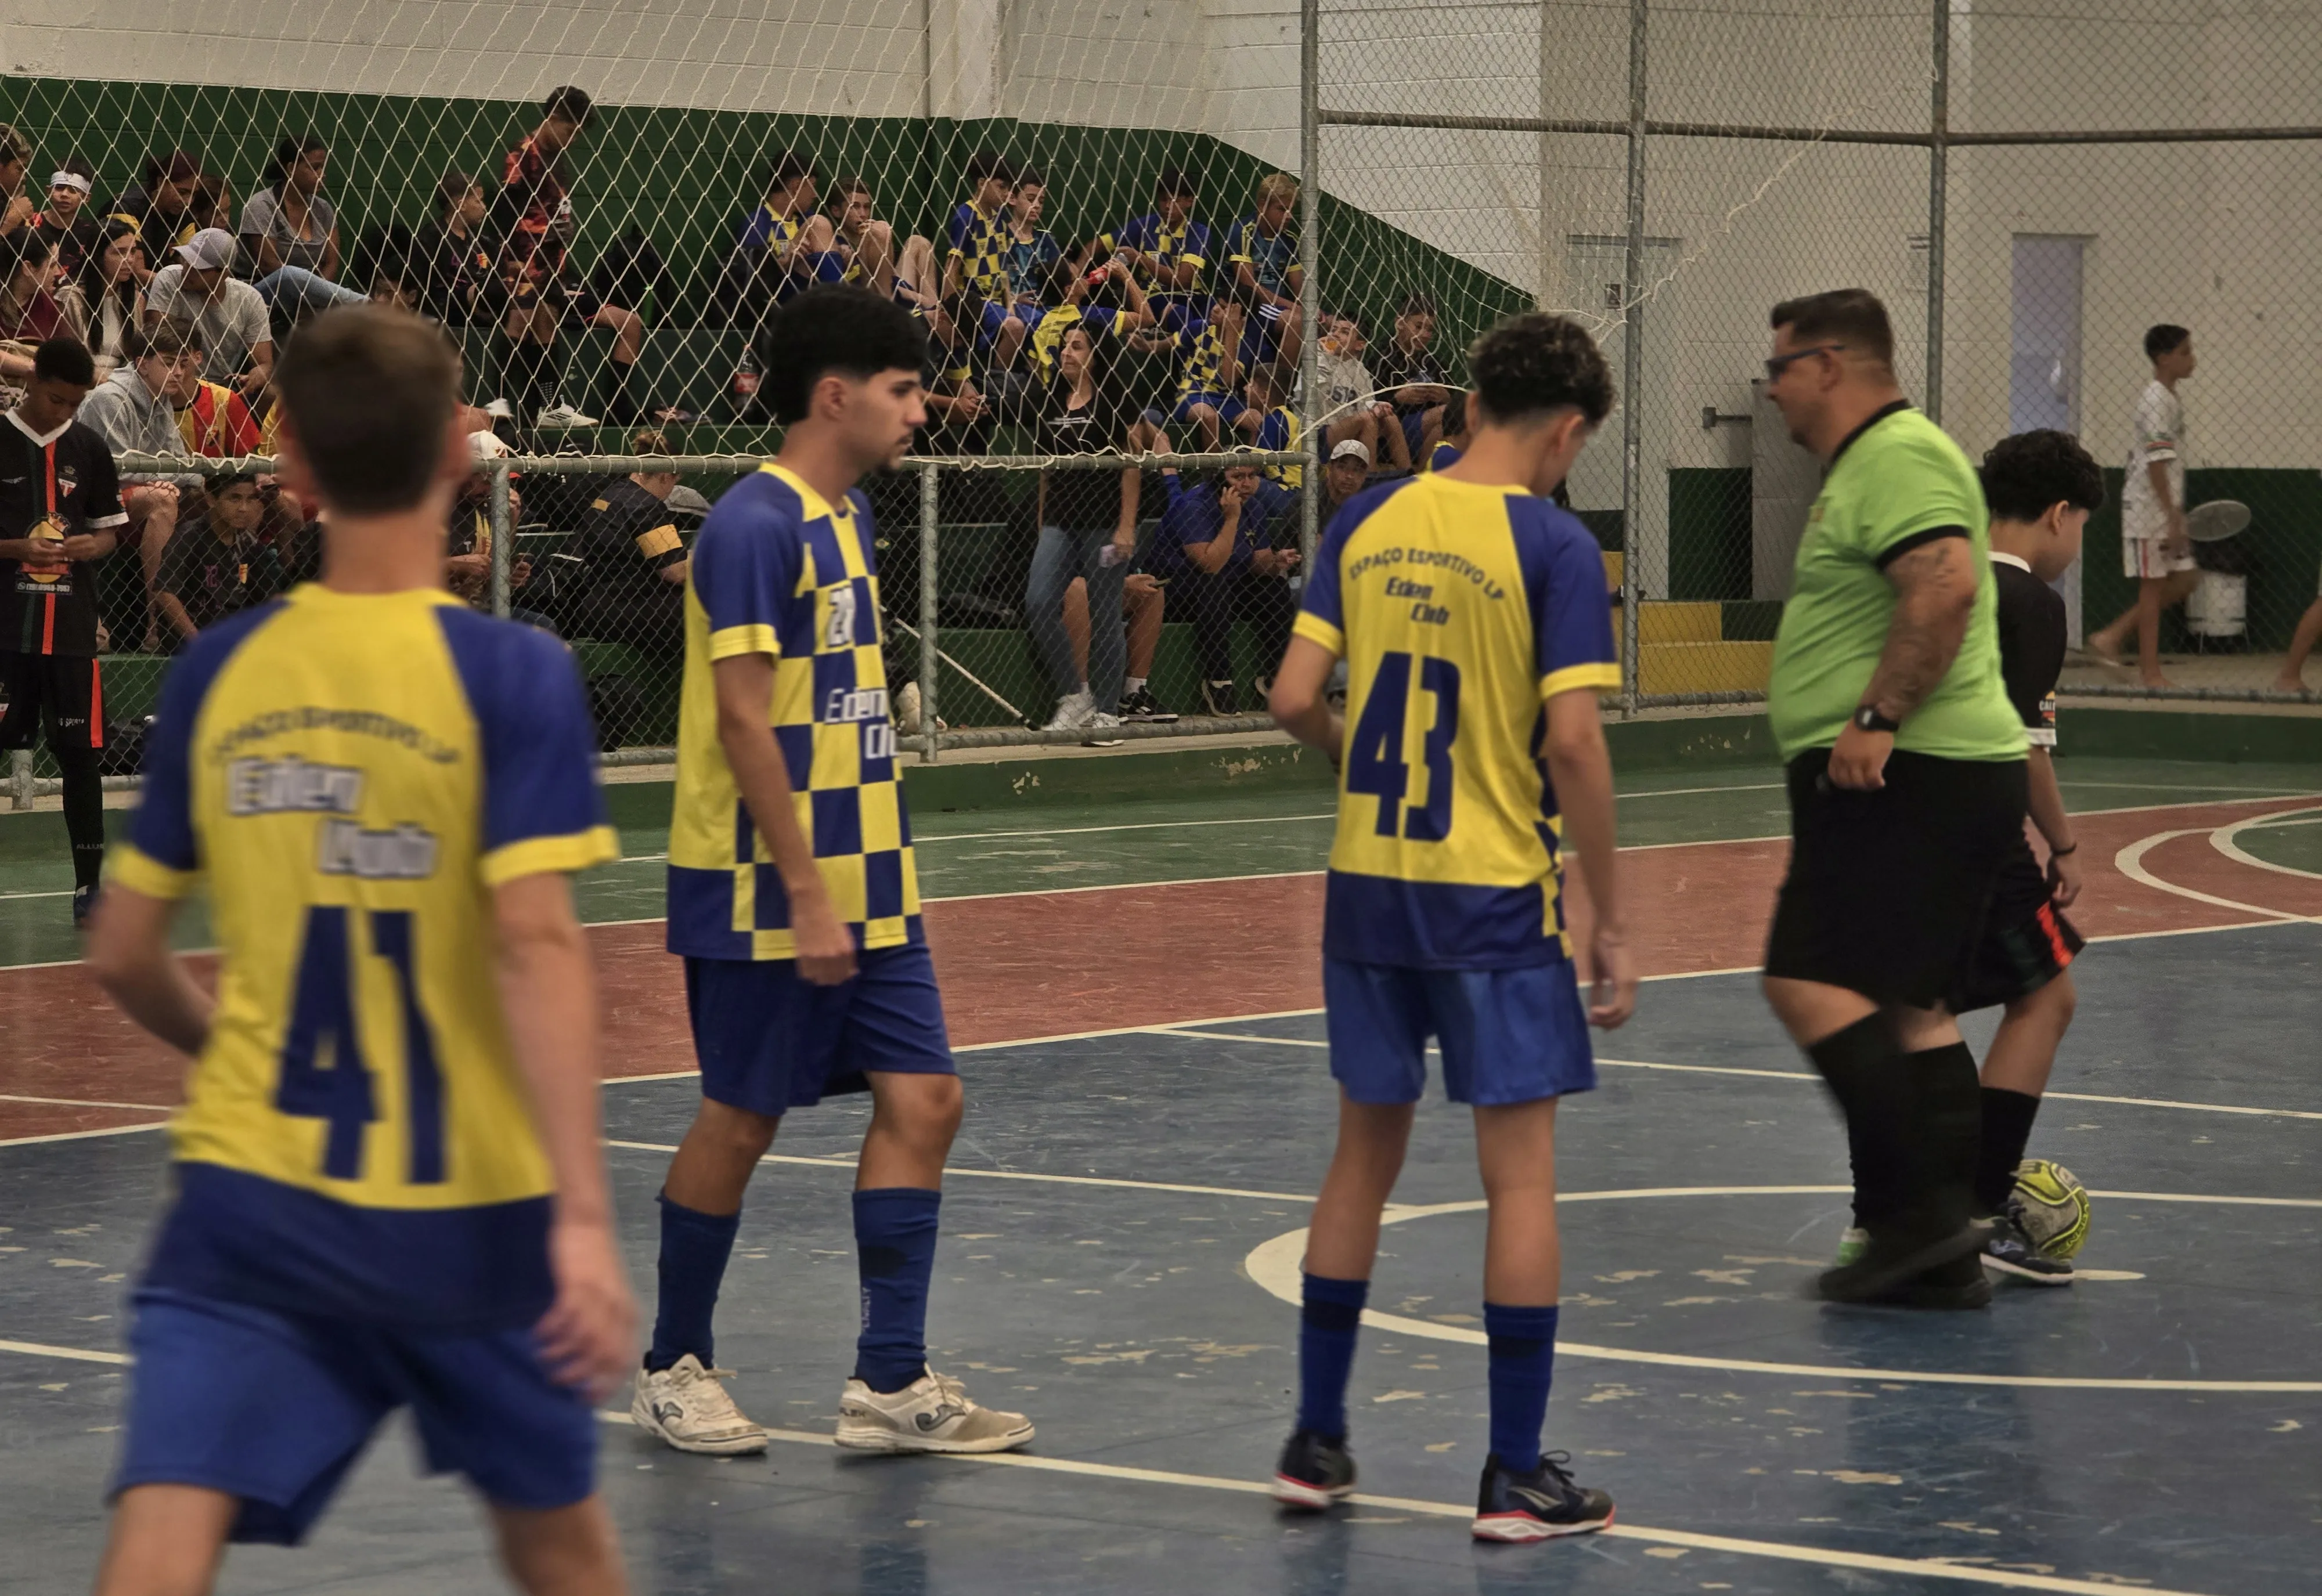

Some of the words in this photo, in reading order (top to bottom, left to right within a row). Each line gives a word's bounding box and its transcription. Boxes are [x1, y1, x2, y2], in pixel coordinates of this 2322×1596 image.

[1349, 547, 1403, 580] ESPAÇO
[1407, 548, 1485, 584] ESPORTIVO
[1385, 576, 1434, 600] Eden
[1410, 602, 1450, 626] Club
[1346, 651, 1461, 842] 43
[272, 904, 453, 1186] 41
